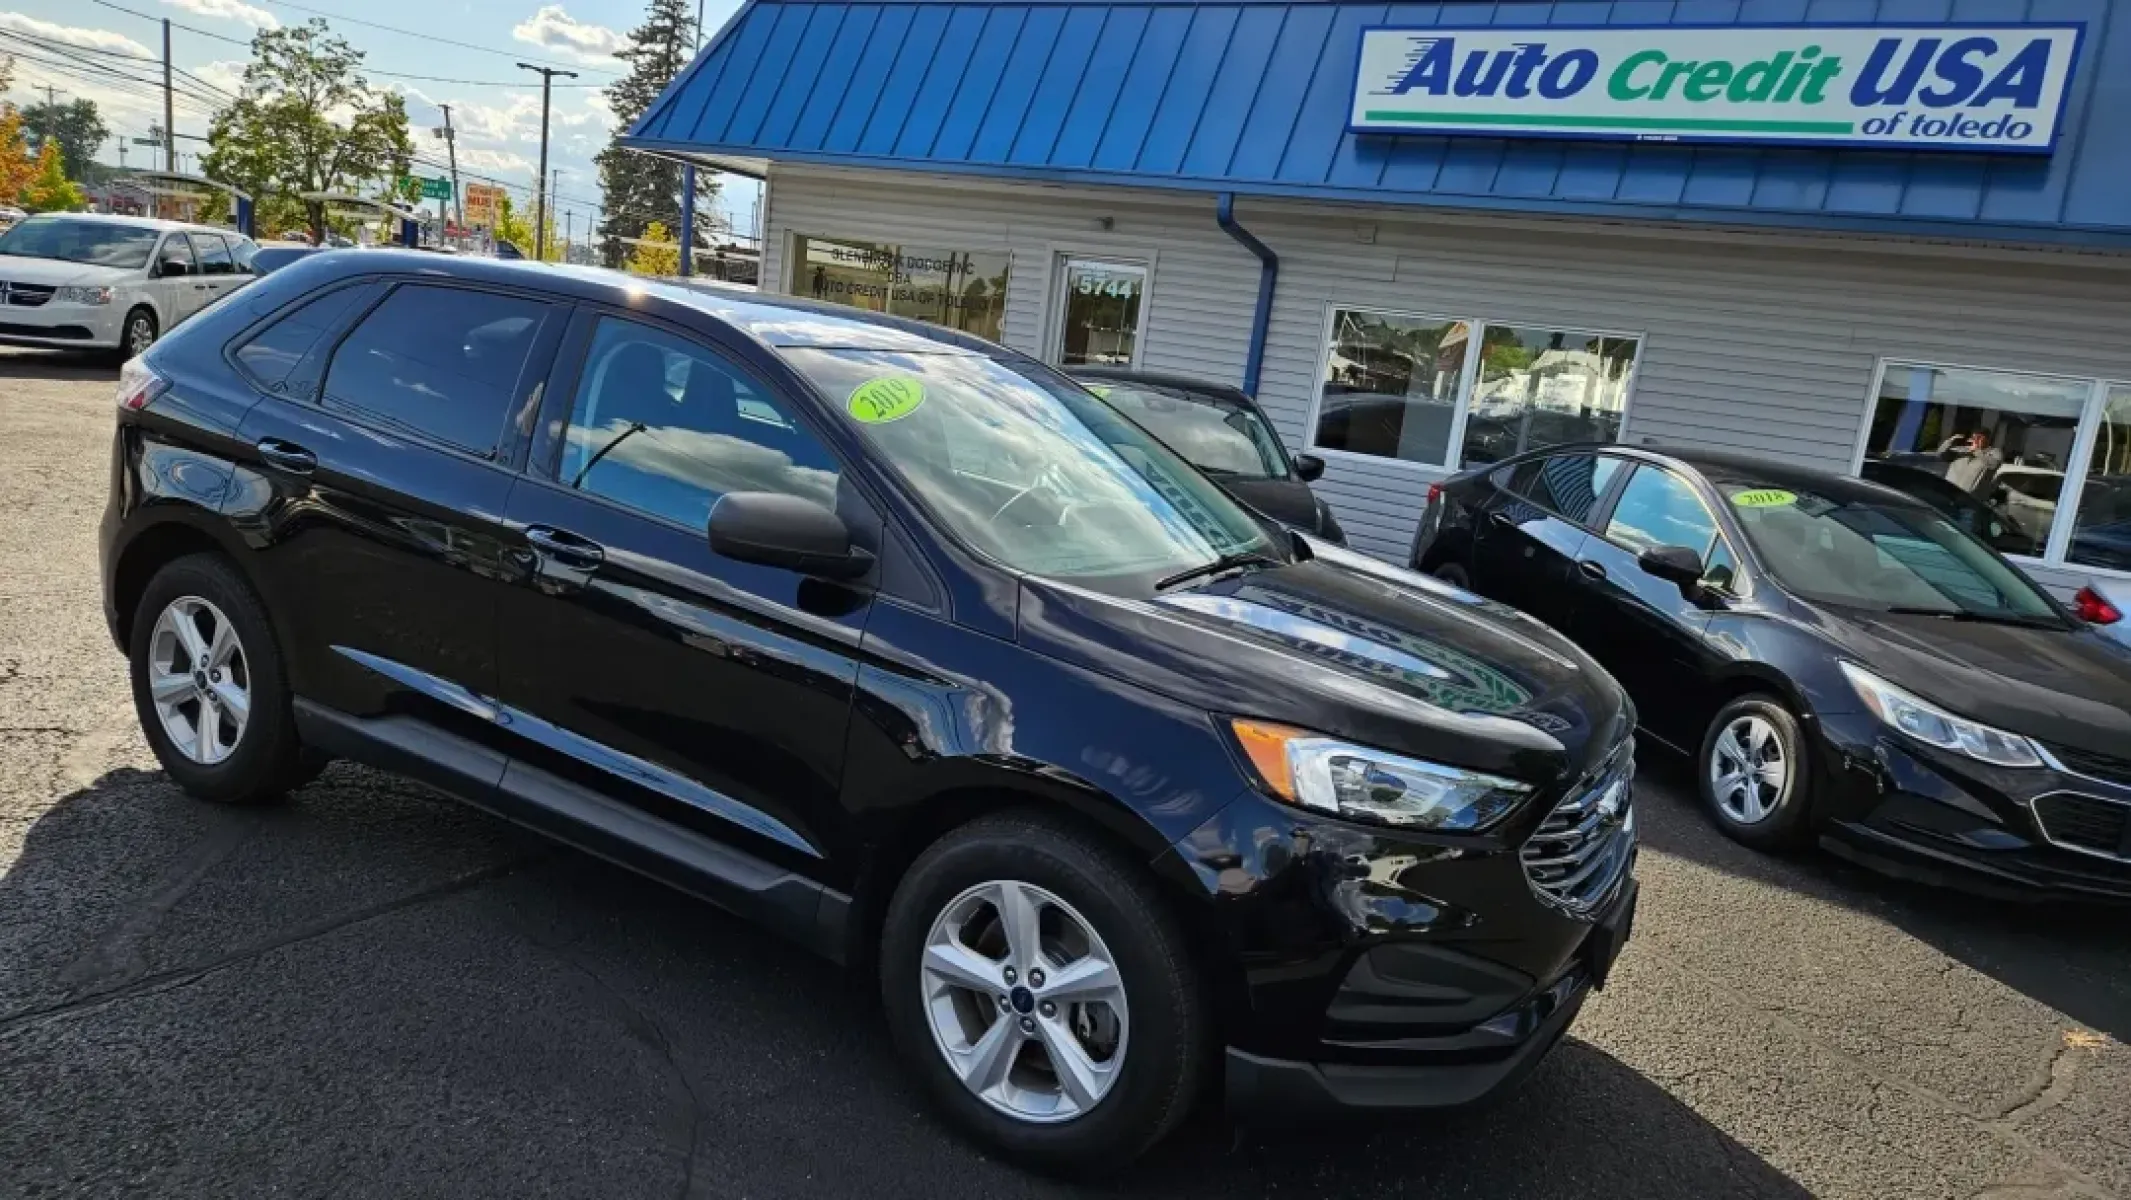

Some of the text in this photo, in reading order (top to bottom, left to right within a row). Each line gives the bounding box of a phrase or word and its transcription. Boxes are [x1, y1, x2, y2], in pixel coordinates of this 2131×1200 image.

[1376, 37, 2053, 108] Auto Credit USA
[1861, 111, 2033, 140] of toledo
[1079, 275, 1132, 299] 5744
[859, 378, 911, 419] 2019
[1743, 491, 1785, 504] 2018
